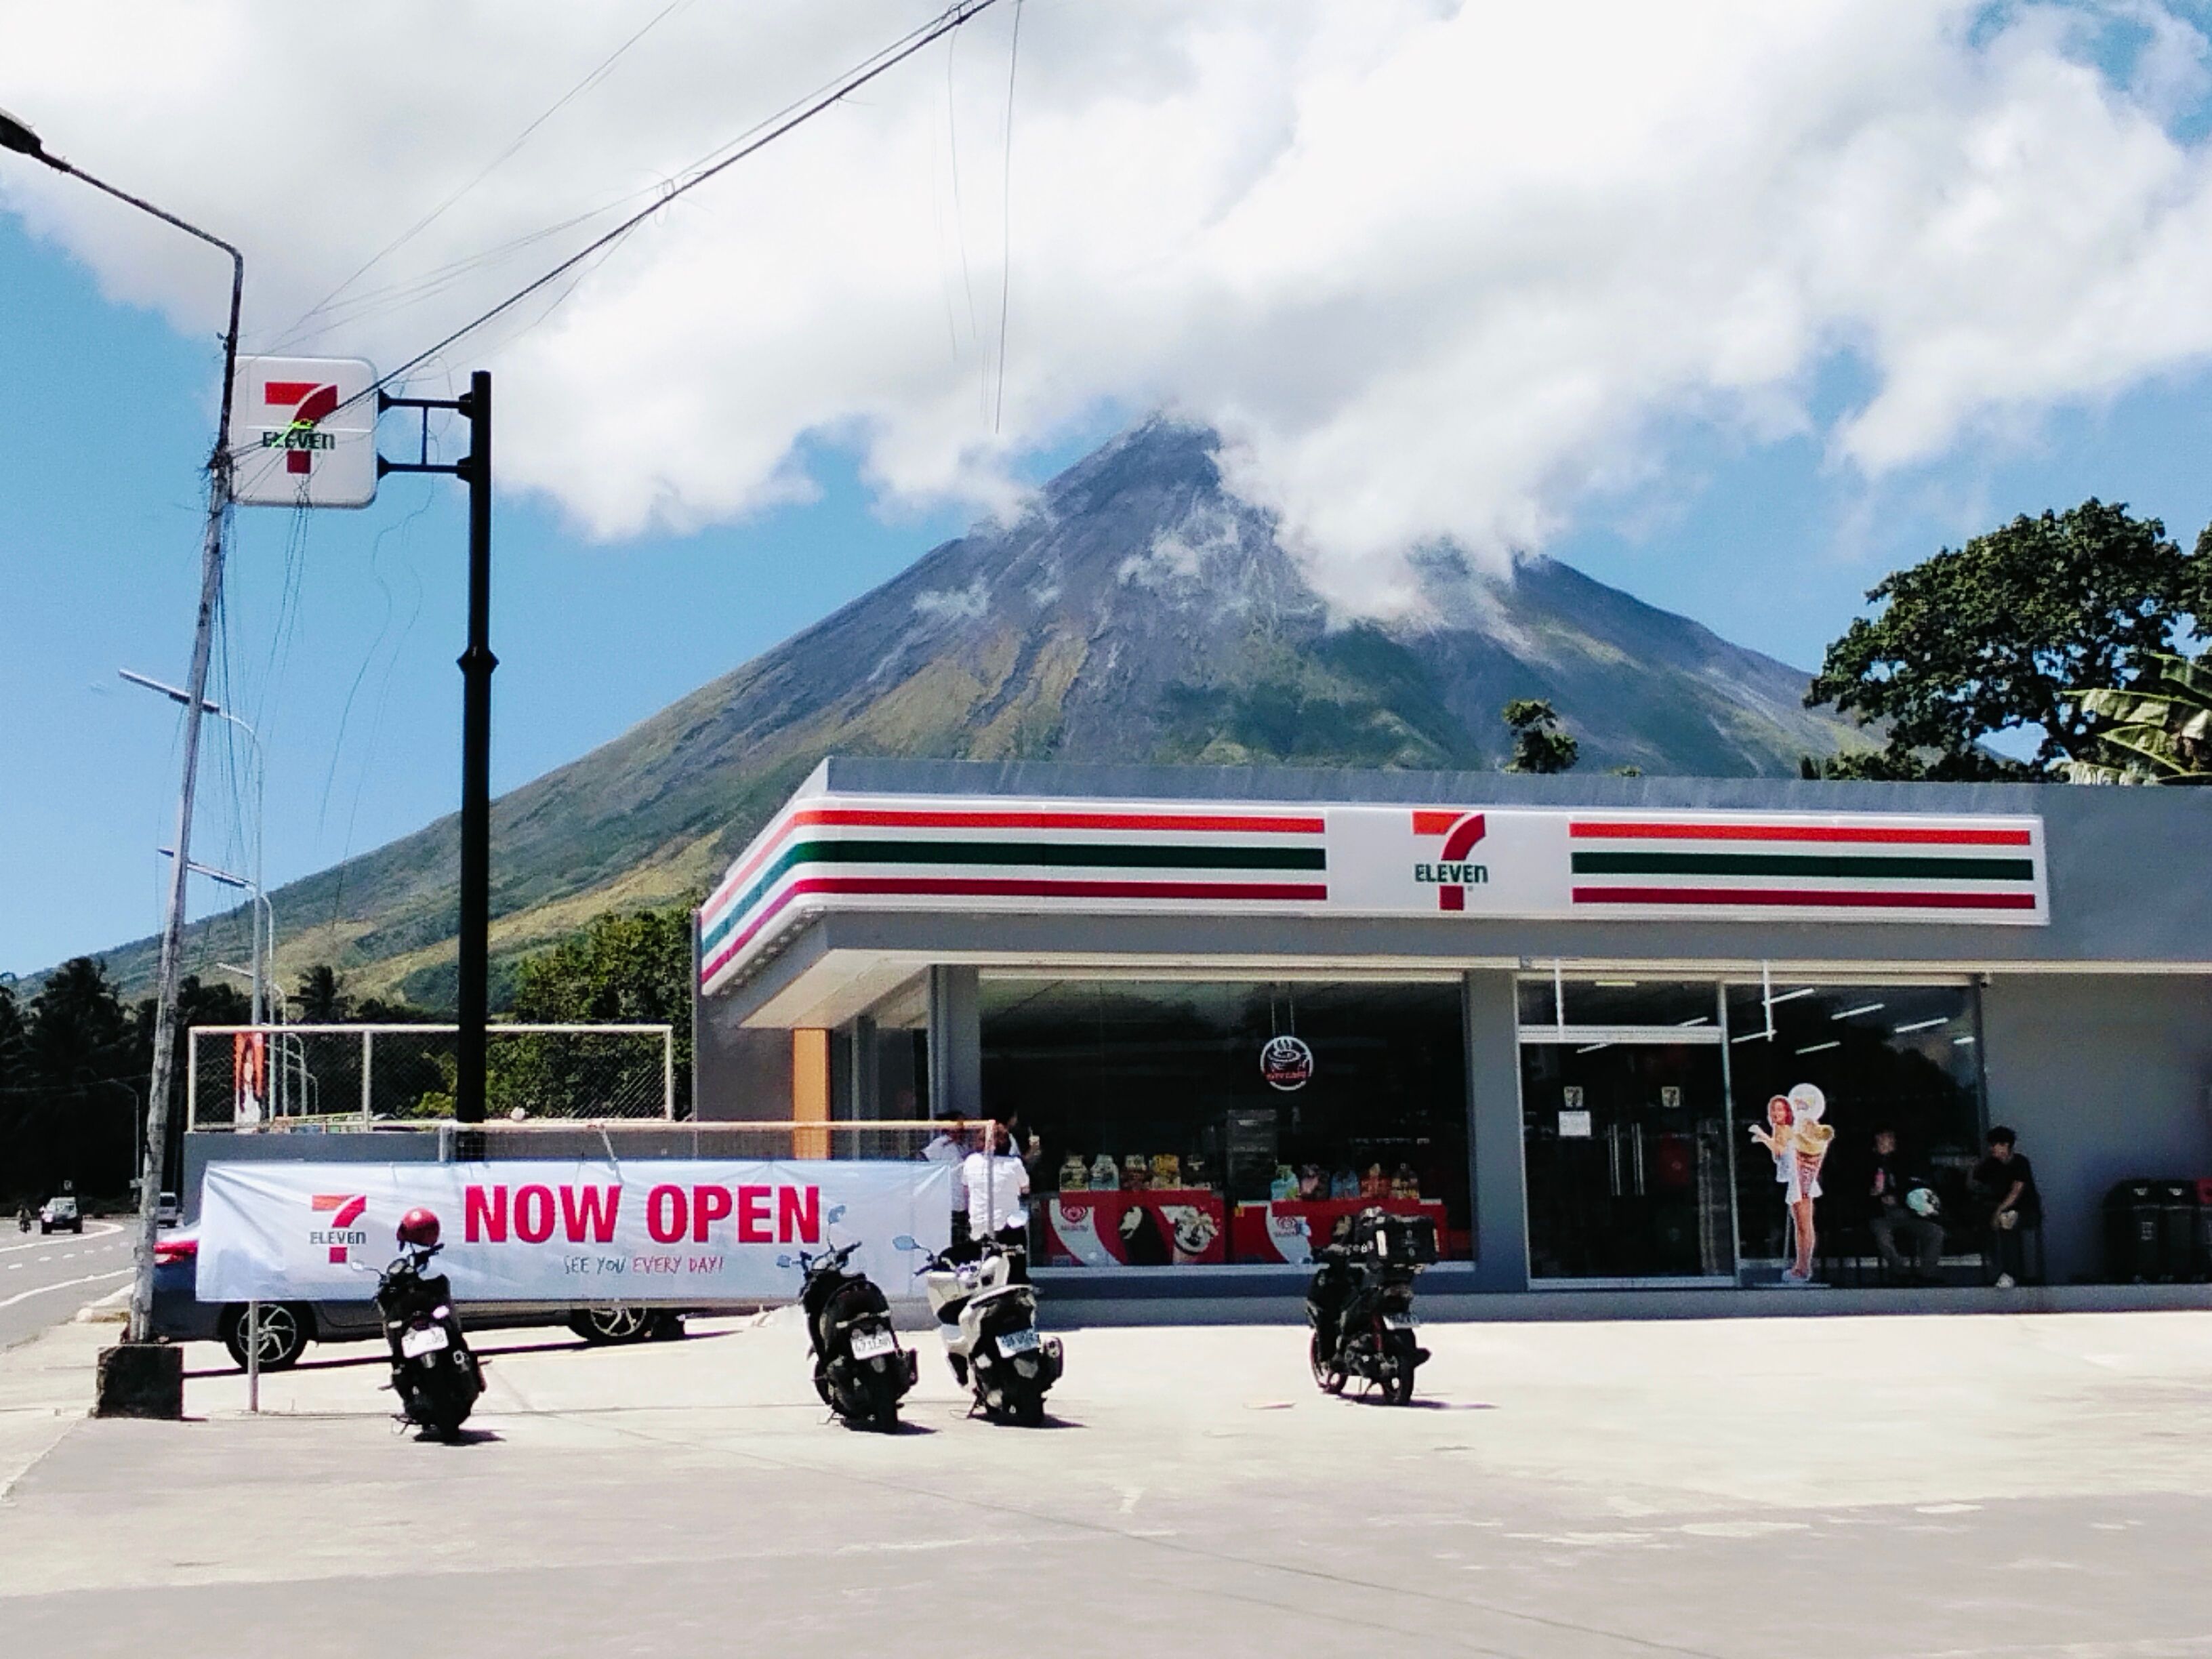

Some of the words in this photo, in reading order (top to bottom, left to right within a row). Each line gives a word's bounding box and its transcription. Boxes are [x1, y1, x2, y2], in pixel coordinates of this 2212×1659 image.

[265, 382, 337, 474] 7
[1413, 811, 1486, 910] 7
[312, 1195, 367, 1264] 7
[465, 1184, 623, 1244] NOW
[647, 1184, 819, 1244] OPEN
[565, 1256, 590, 1275] SEE
[596, 1256, 626, 1274] YOU
[632, 1256, 682, 1274] EVERY
[689, 1256, 724, 1274] DAY!
